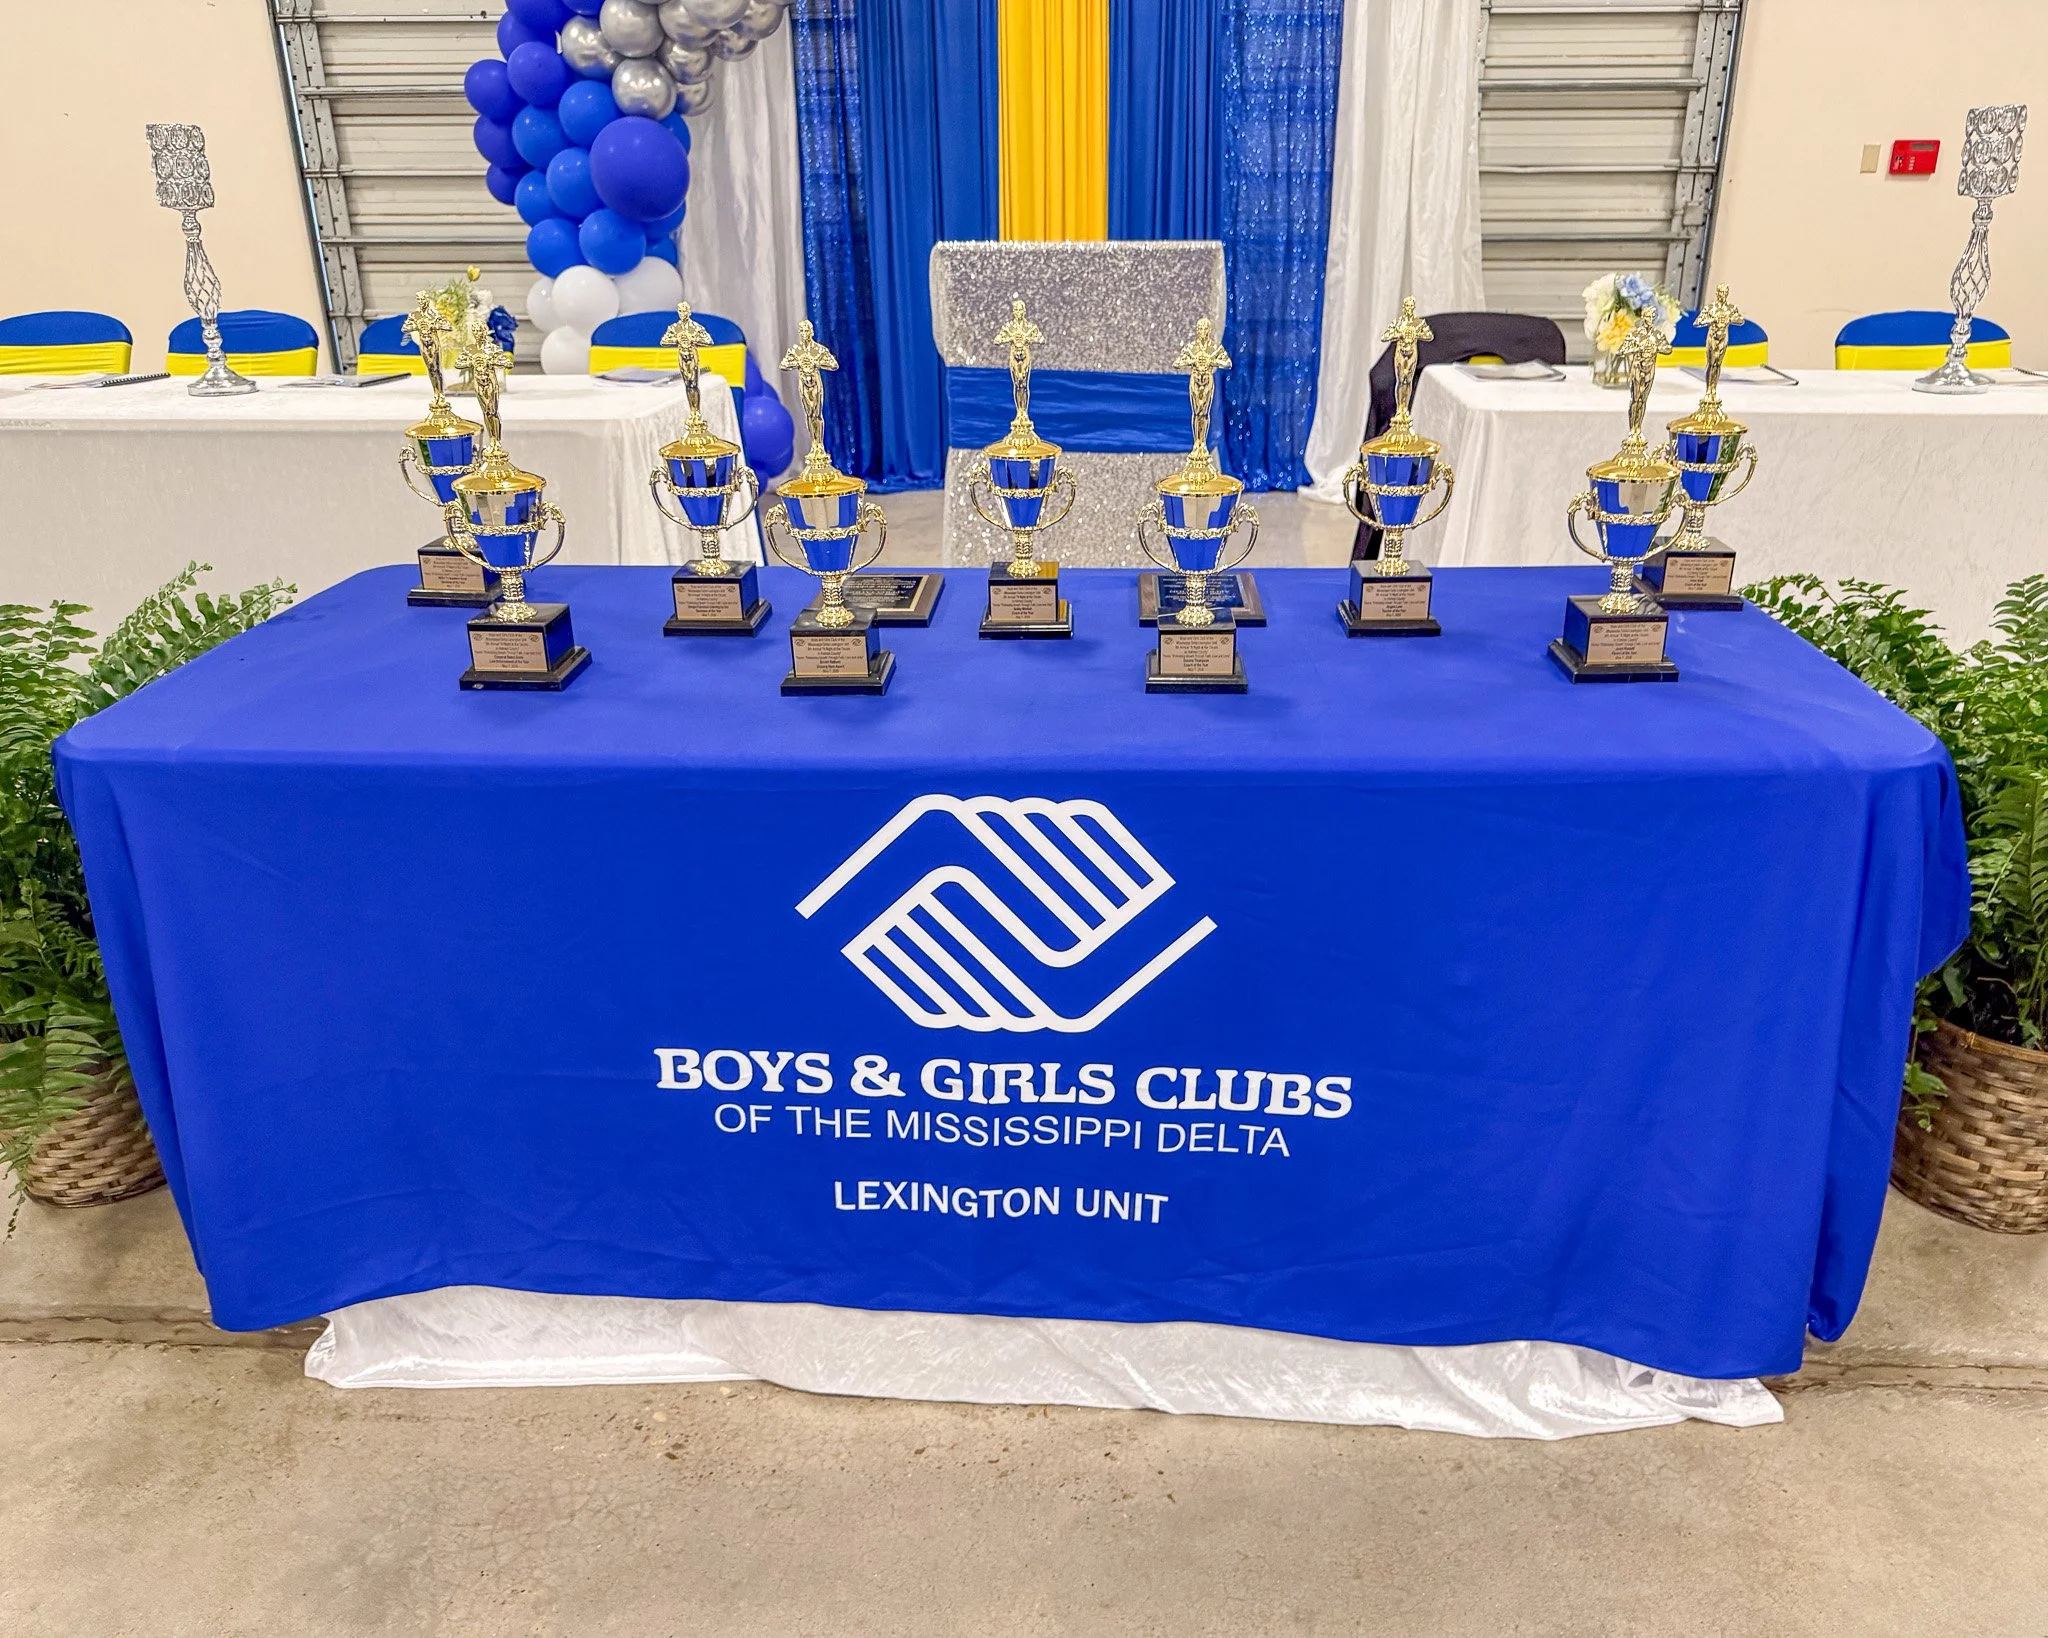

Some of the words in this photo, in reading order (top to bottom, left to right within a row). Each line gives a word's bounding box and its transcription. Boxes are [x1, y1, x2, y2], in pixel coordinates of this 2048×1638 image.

[653, 1048, 834, 1093] BOYS
[850, 1054, 907, 1097] &
[920, 1058, 1116, 1105] GIRLS
[1135, 1066, 1352, 1119] CLUBS
[714, 1103, 773, 1133] OF
[785, 1105, 872, 1138] THE
[887, 1109, 1142, 1150] MISSISSIPPI
[1157, 1122, 1290, 1157] DELTA
[834, 1181, 1060, 1218] LEXINGTON
[1075, 1187, 1169, 1224] UNIT
